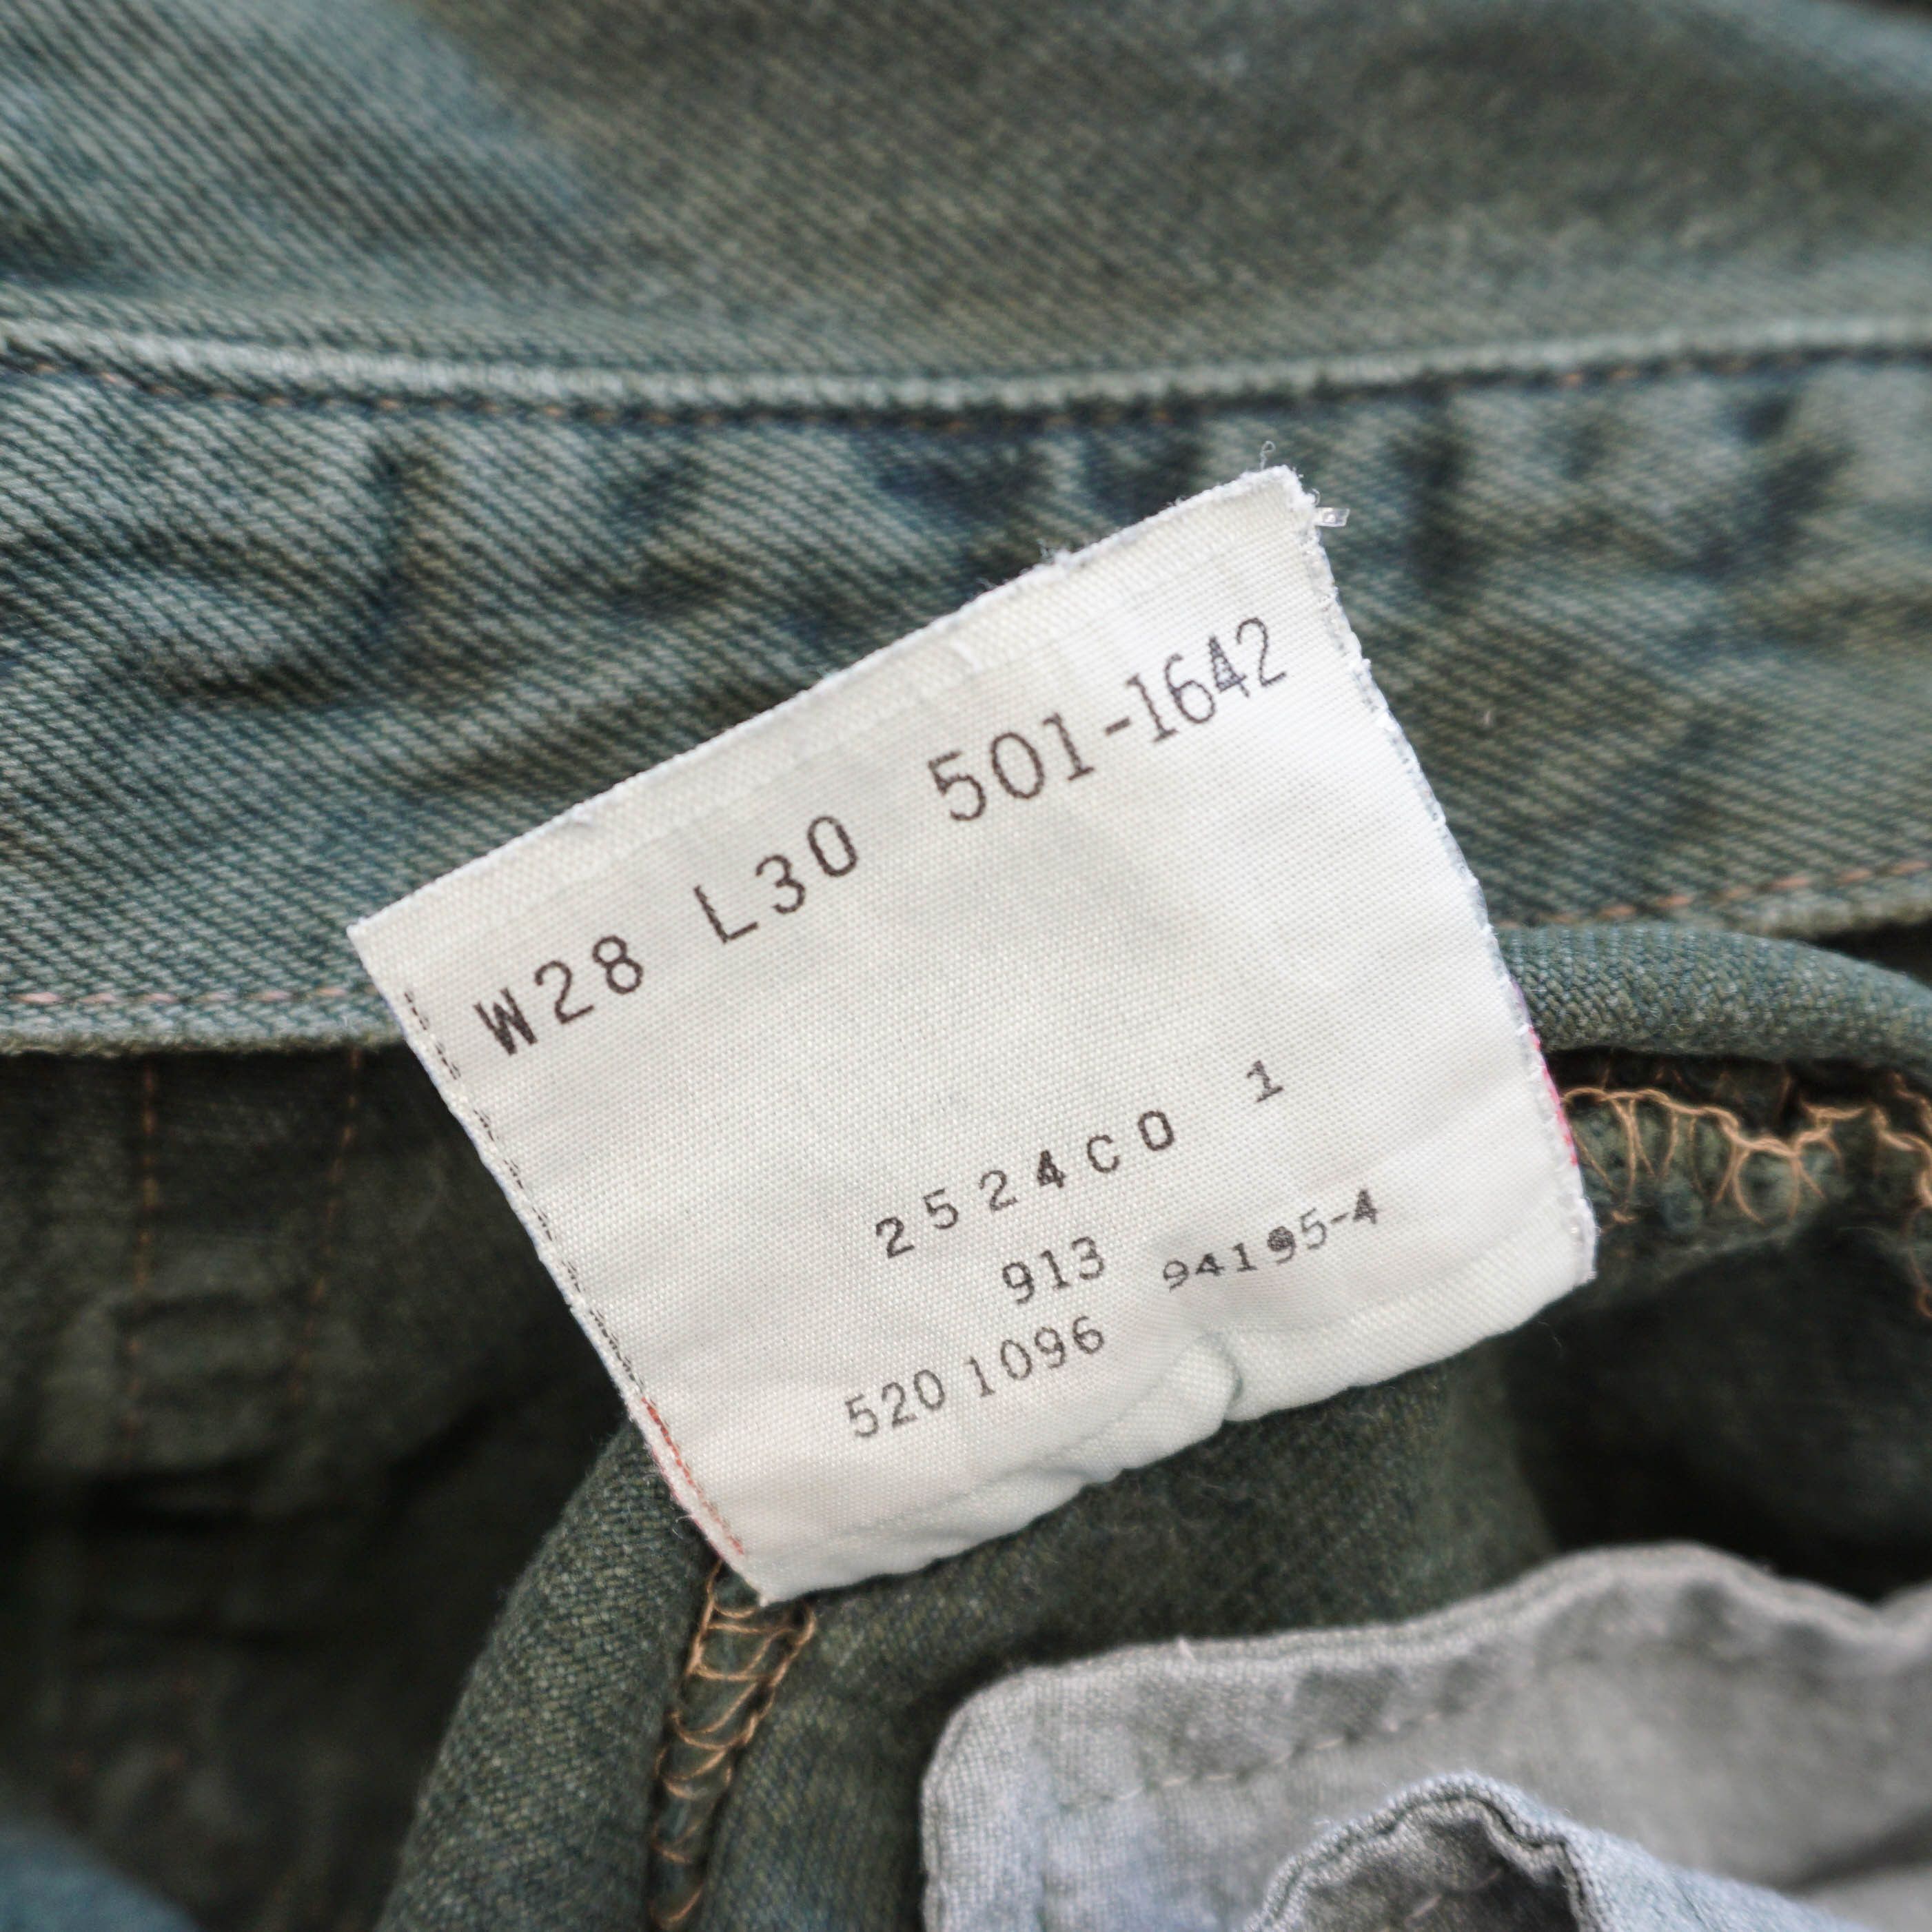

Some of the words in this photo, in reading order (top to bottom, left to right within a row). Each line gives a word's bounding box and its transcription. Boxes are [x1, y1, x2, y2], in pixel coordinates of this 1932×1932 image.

[473, 935, 643, 1056] W28
[693, 816, 857, 943] L30
[928, 617, 1287, 822] 501-1642
[1247, 1060, 1283, 1103] 1
[1002, 1236, 1104, 1305] 913
